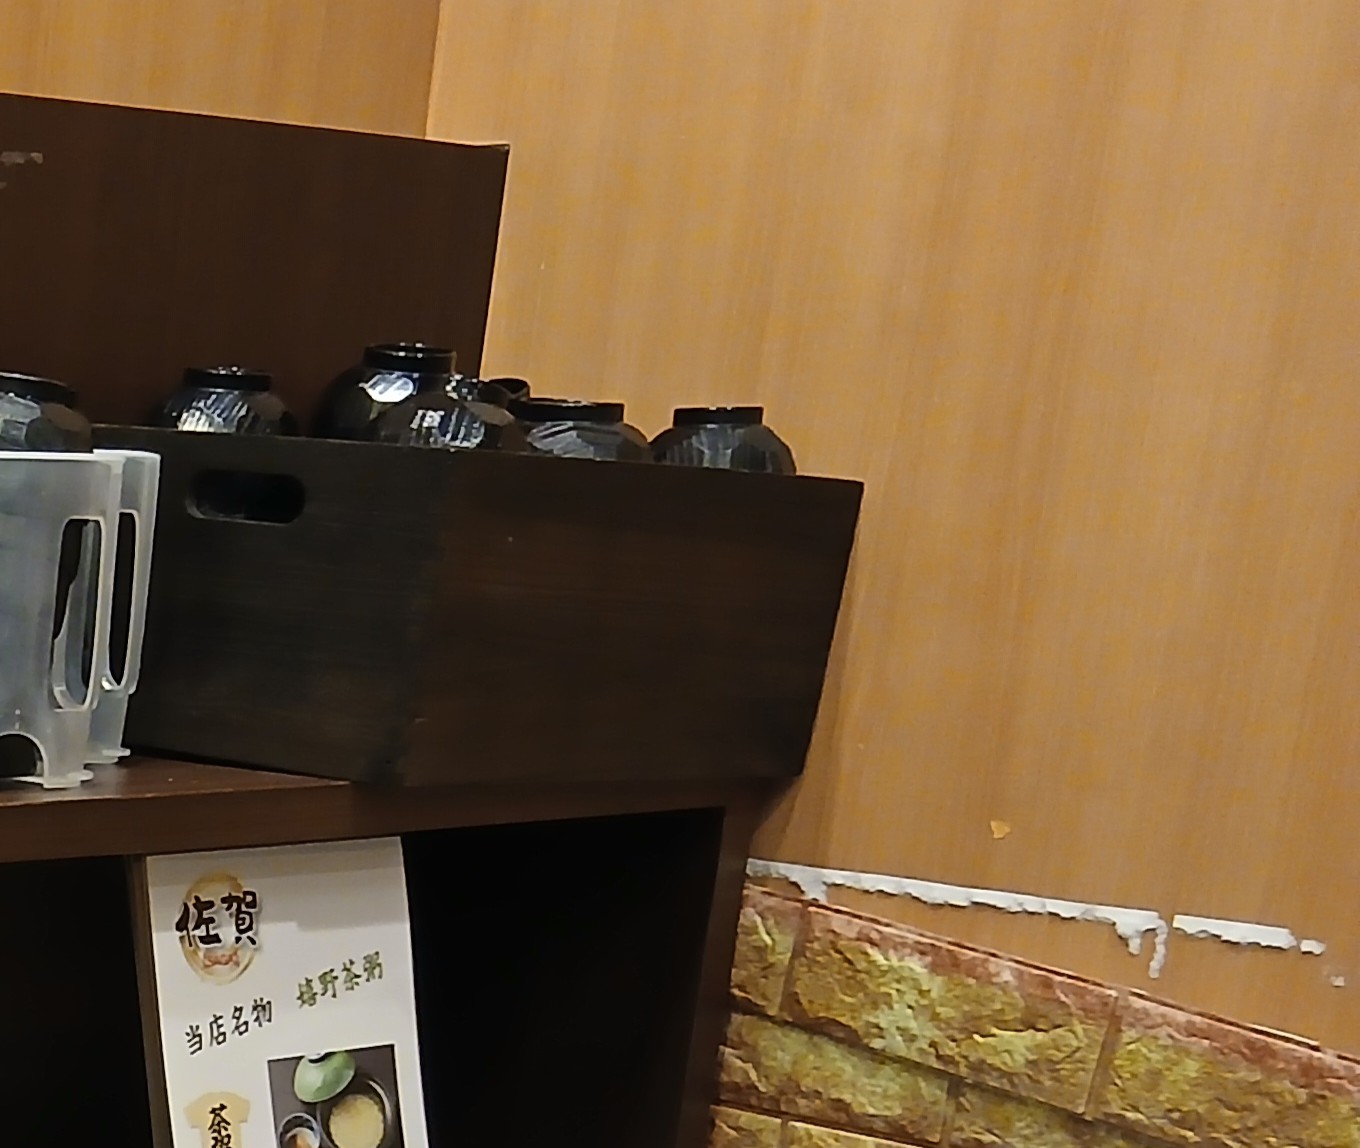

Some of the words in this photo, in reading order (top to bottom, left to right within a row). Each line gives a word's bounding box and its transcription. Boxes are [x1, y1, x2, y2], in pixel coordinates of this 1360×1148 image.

[174, 889, 260, 949] 佐賀
[183, 996, 274, 1056] 当店名物
[295, 950, 385, 1009] 嬉野茶粥
